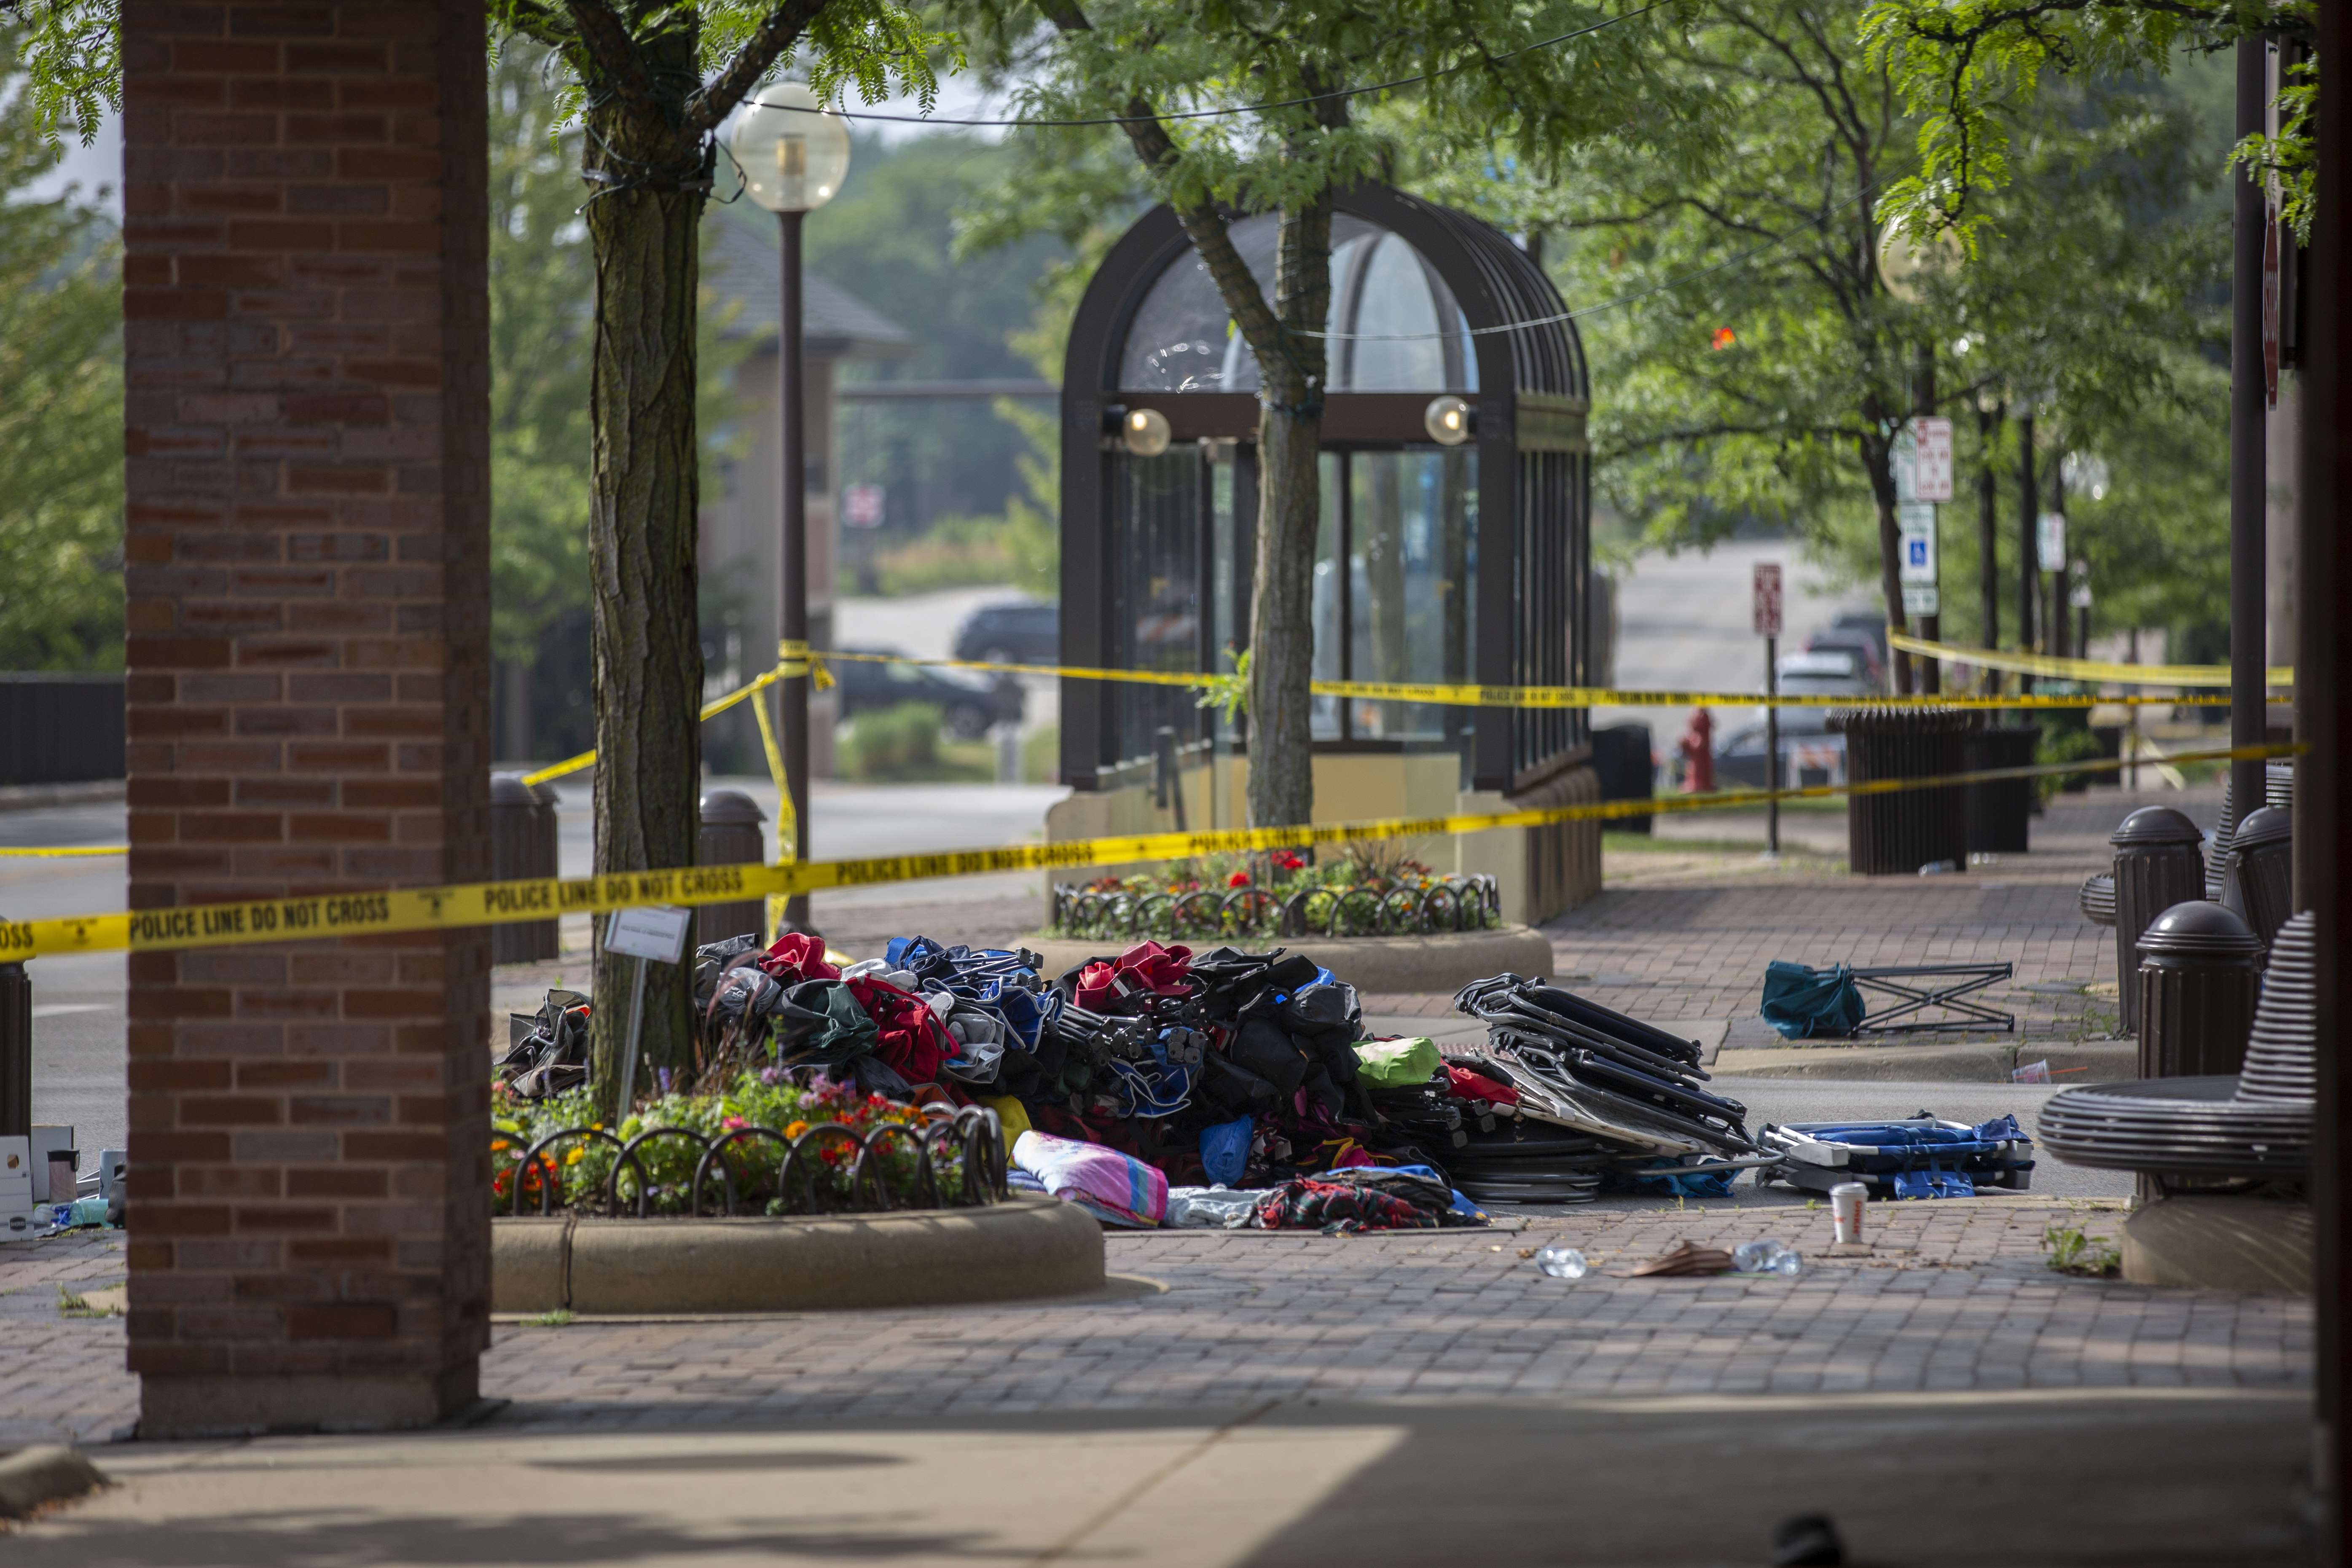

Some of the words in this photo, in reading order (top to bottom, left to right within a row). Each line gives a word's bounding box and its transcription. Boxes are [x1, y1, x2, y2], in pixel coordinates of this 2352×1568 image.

[486, 885, 551, 913] POLICE
[558, 880, 597, 907] LINE
[606, 877, 631, 903] DO
[638, 875, 673, 900] NOT
[682, 870, 743, 897] CROSS
[837, 857, 900, 885] POLICE
[130, 911, 196, 942] POLICE
[203, 908, 244, 934] LINE
[251, 905, 277, 930] DO
[284, 902, 319, 927] NOT
[327, 894, 389, 926] CROSS
